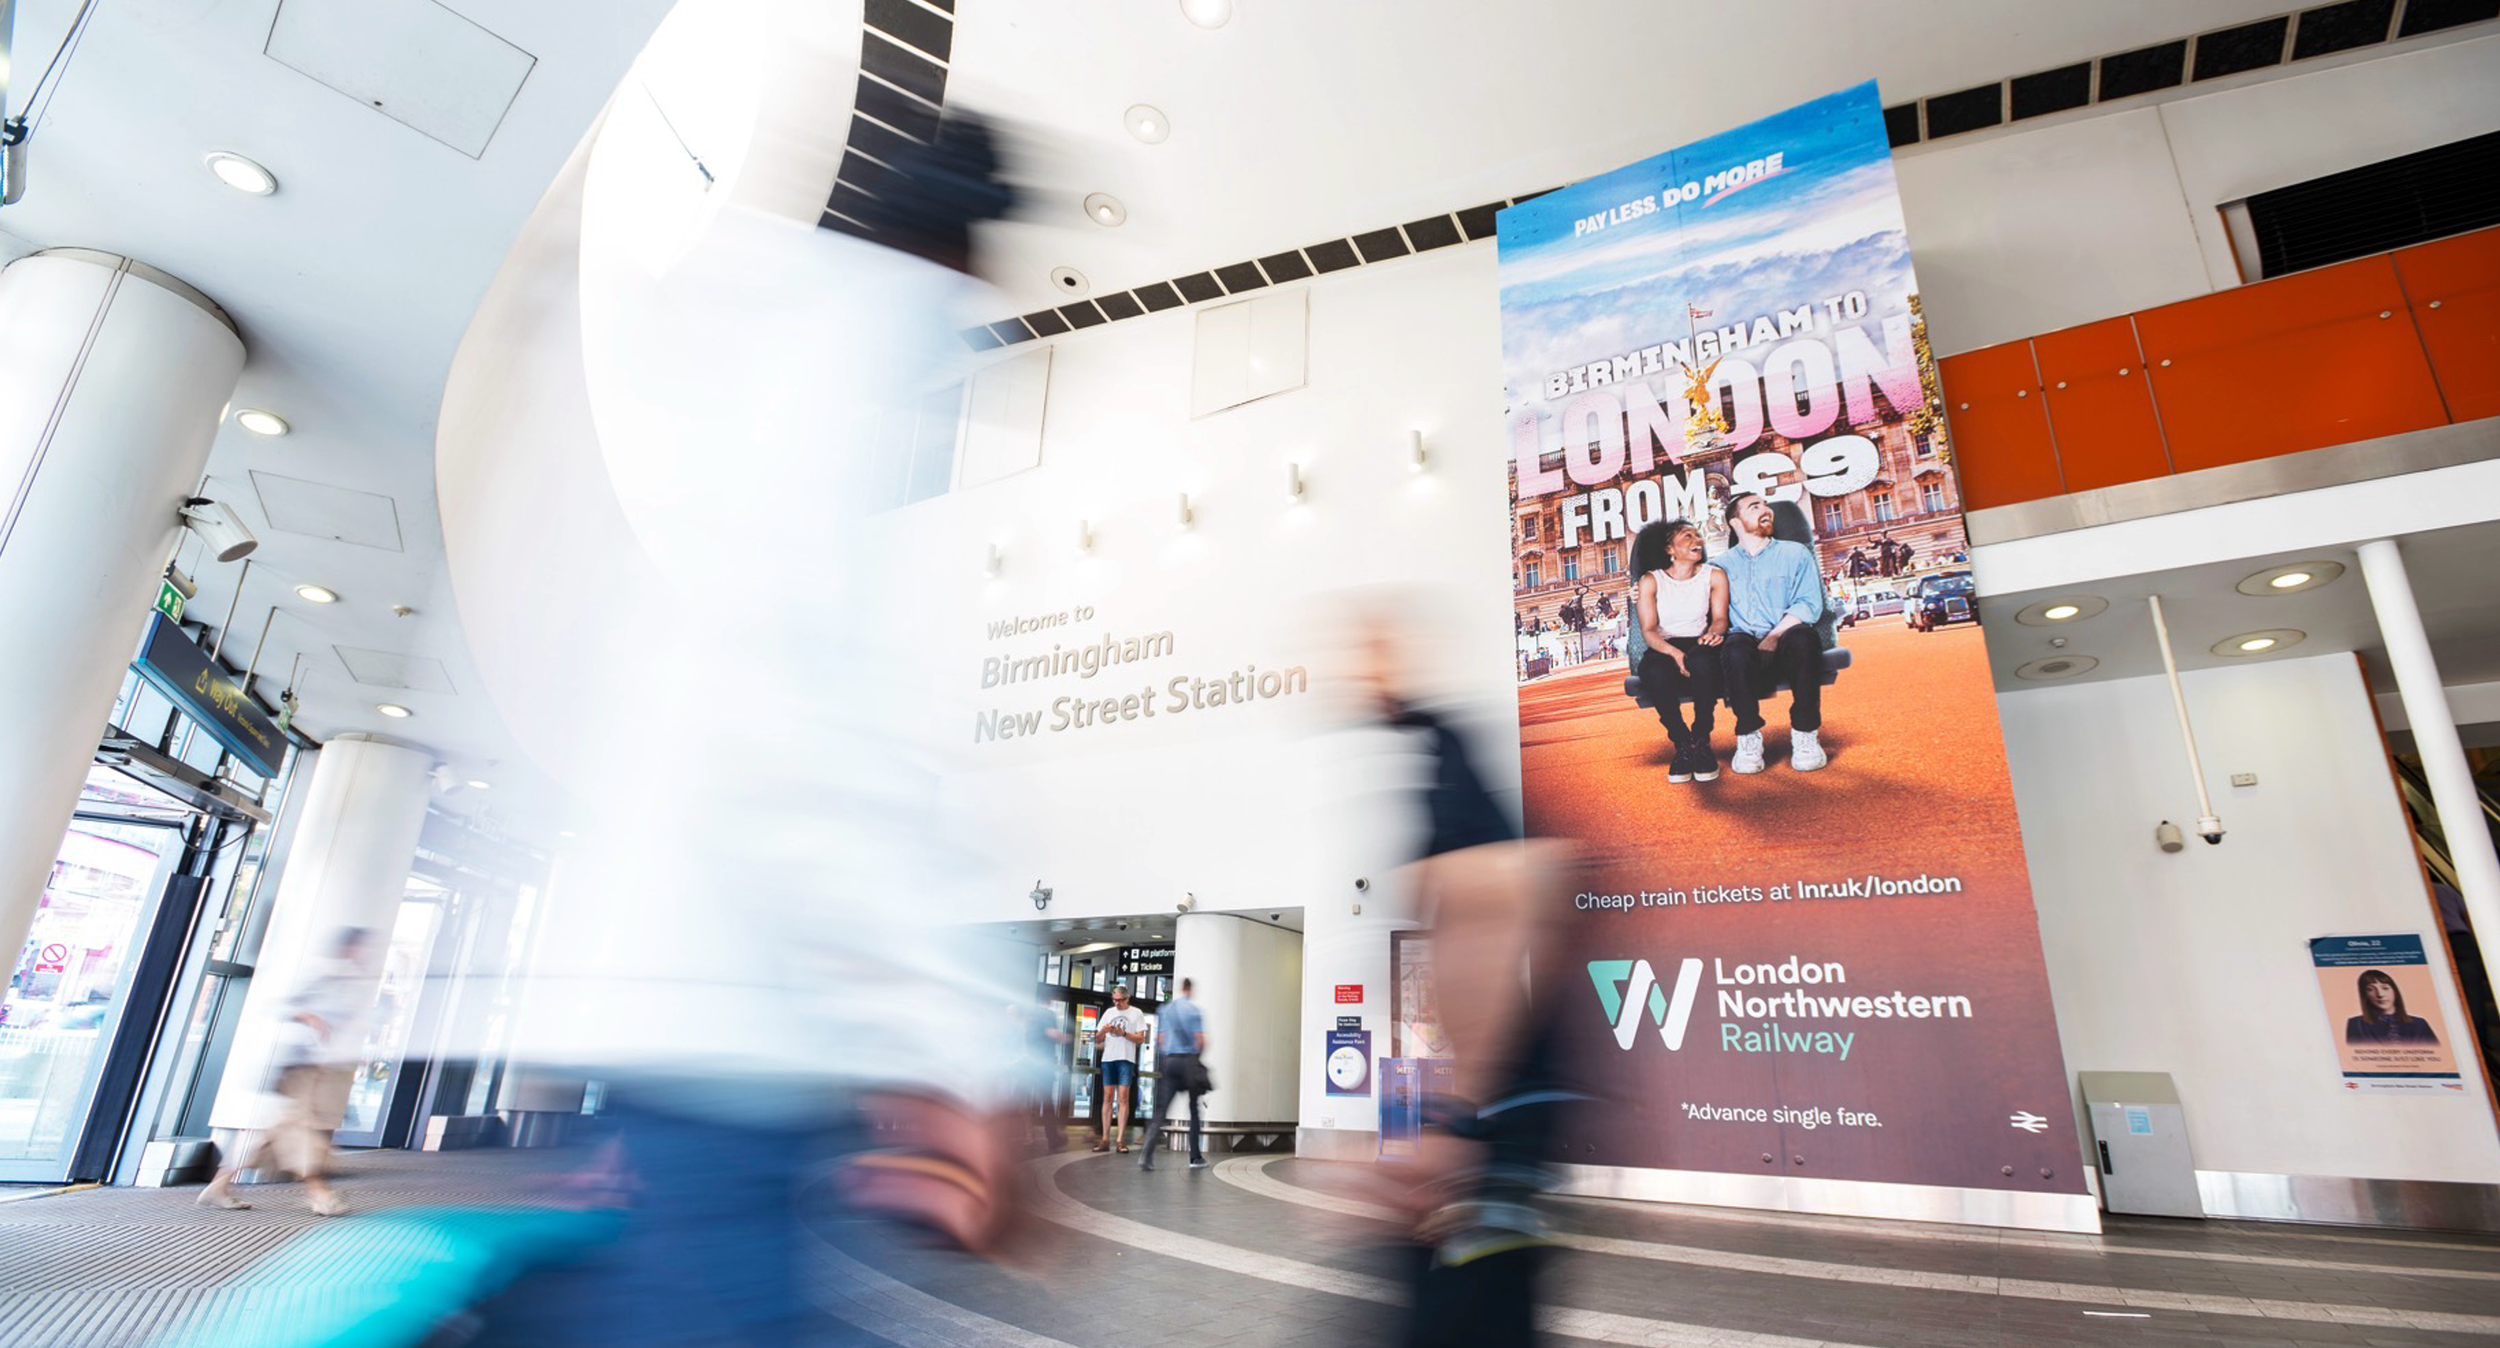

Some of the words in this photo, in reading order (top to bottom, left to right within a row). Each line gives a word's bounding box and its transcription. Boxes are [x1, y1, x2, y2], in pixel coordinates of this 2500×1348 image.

[1574, 210, 1607, 238] PAY
[1609, 194, 1660, 226] LESS.
[1662, 181, 1701, 209] DO
[1703, 151, 1784, 196] MORE
[1544, 304, 1813, 401] BIRMINGHAM
[1823, 290, 1867, 324] TO
[1514, 312, 1925, 500] LONDON
[1561, 467, 1709, 549] FROM
[986, 611, 1068, 641] Welcome
[1073, 604, 1095, 622] to
[980, 629, 1174, 689] Birmingham
[209, 678, 225, 709] Way
[974, 708, 1043, 744] New
[1050, 685, 1157, 733] Street
[1166, 664, 1308, 714] Station
[1575, 892, 1635, 913] Cheap
[1640, 887, 1687, 907] train
[1692, 885, 1763, 904] tickets
[1769, 882, 1792, 900] at
[1797, 873, 1962, 899] lnr.uk/london
[1140, 963, 1163, 971] Tickets
[1150, 948, 1176, 959] platform
[1714, 955, 1846, 985] London
[1717, 988, 1973, 1018] Northwestern
[1720, 1022, 1855, 1061] Railway
[1773, 1105, 1832, 1130] single
[1836, 1107, 1884, 1128] fare.
